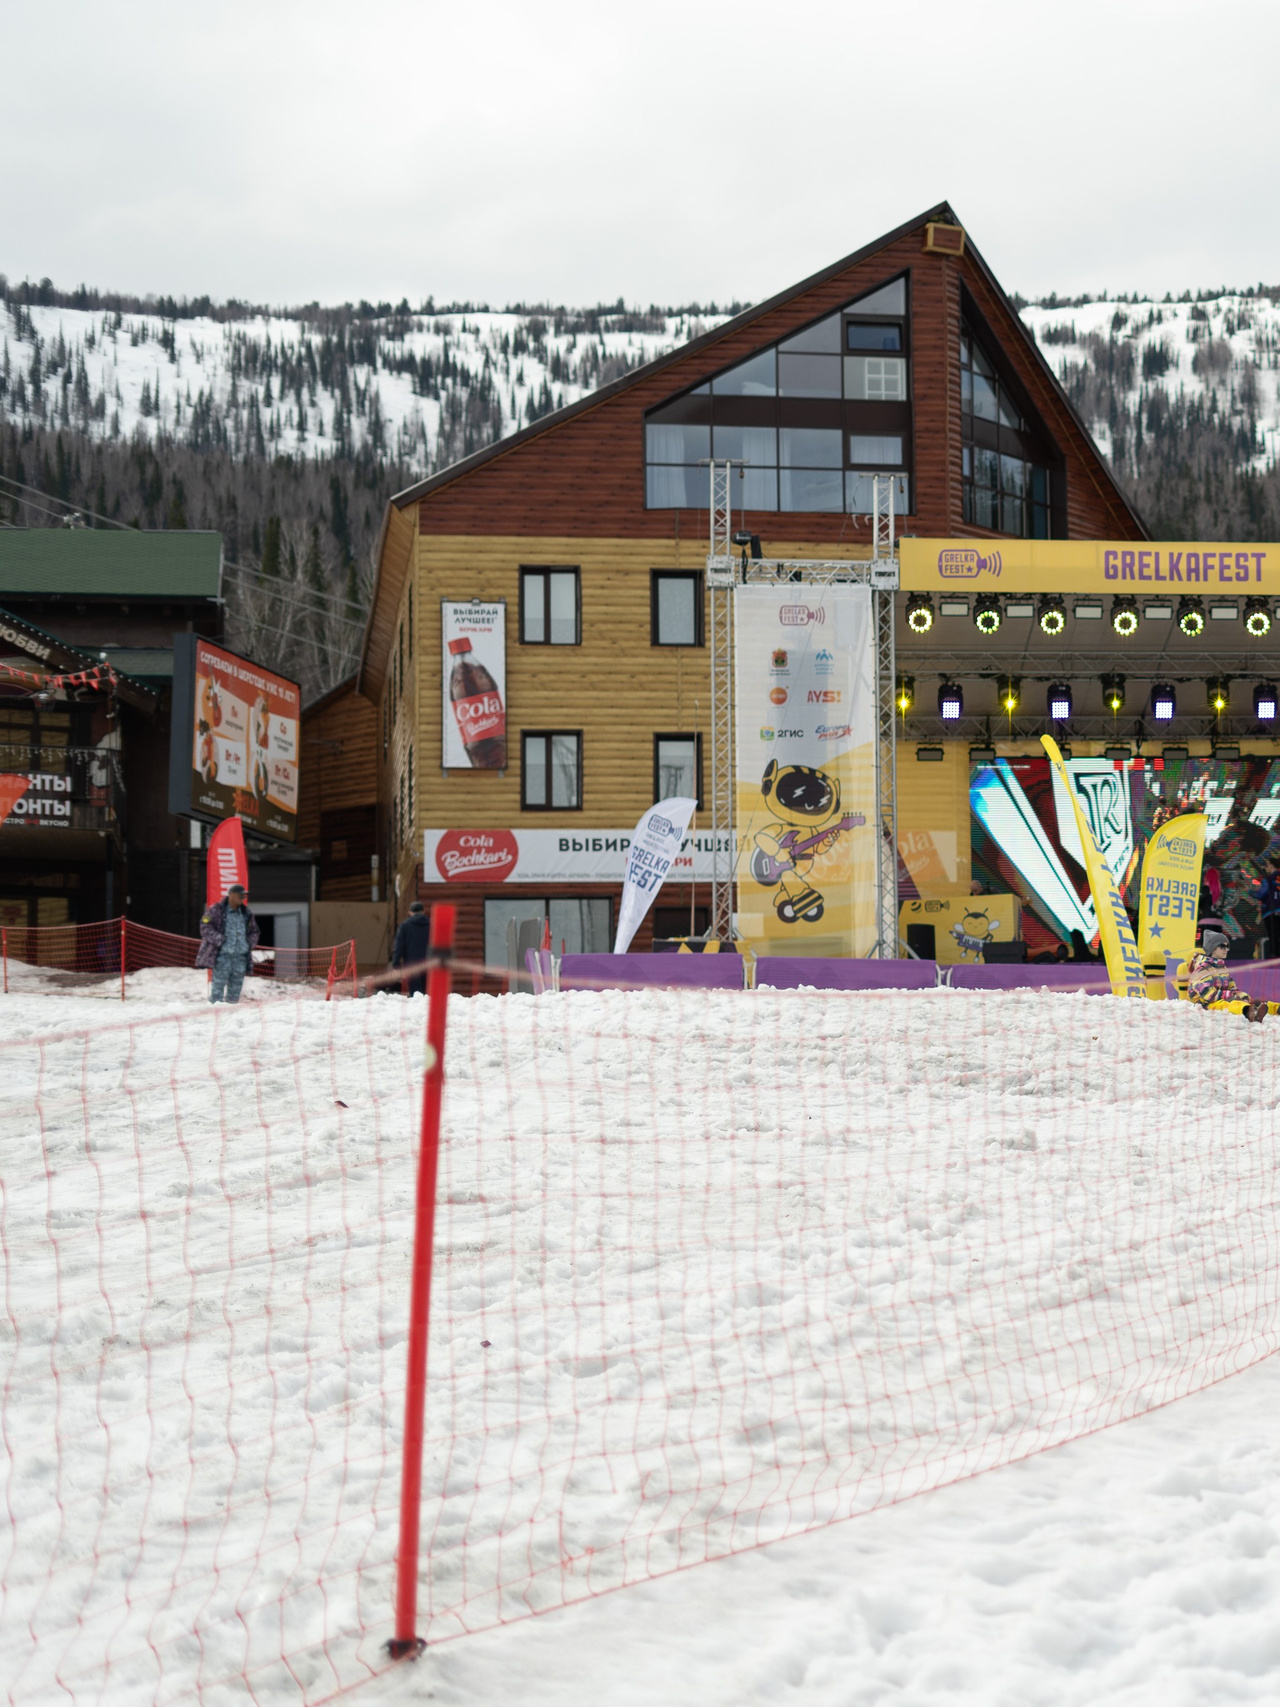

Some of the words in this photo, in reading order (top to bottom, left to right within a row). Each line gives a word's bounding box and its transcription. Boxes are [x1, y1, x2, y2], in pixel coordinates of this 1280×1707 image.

[944, 553, 975, 563] GRELKA
[1104, 550, 1266, 582] GRELKAFEST
[944, 564, 965, 574] FEST
[453, 607, 498, 616] ВЫБИРАЙ
[0, 623, 51, 661] ЮБВИ
[456, 695, 501, 723] Cola
[777, 729, 804, 738] 2ГИС
[10, 773, 71, 792] НТЫ
[10, 798, 71, 816] ОНТЫ
[459, 834, 494, 848] Cola
[558, 838, 631, 852] ВЫБИР
[441, 848, 512, 874] Bochkari
